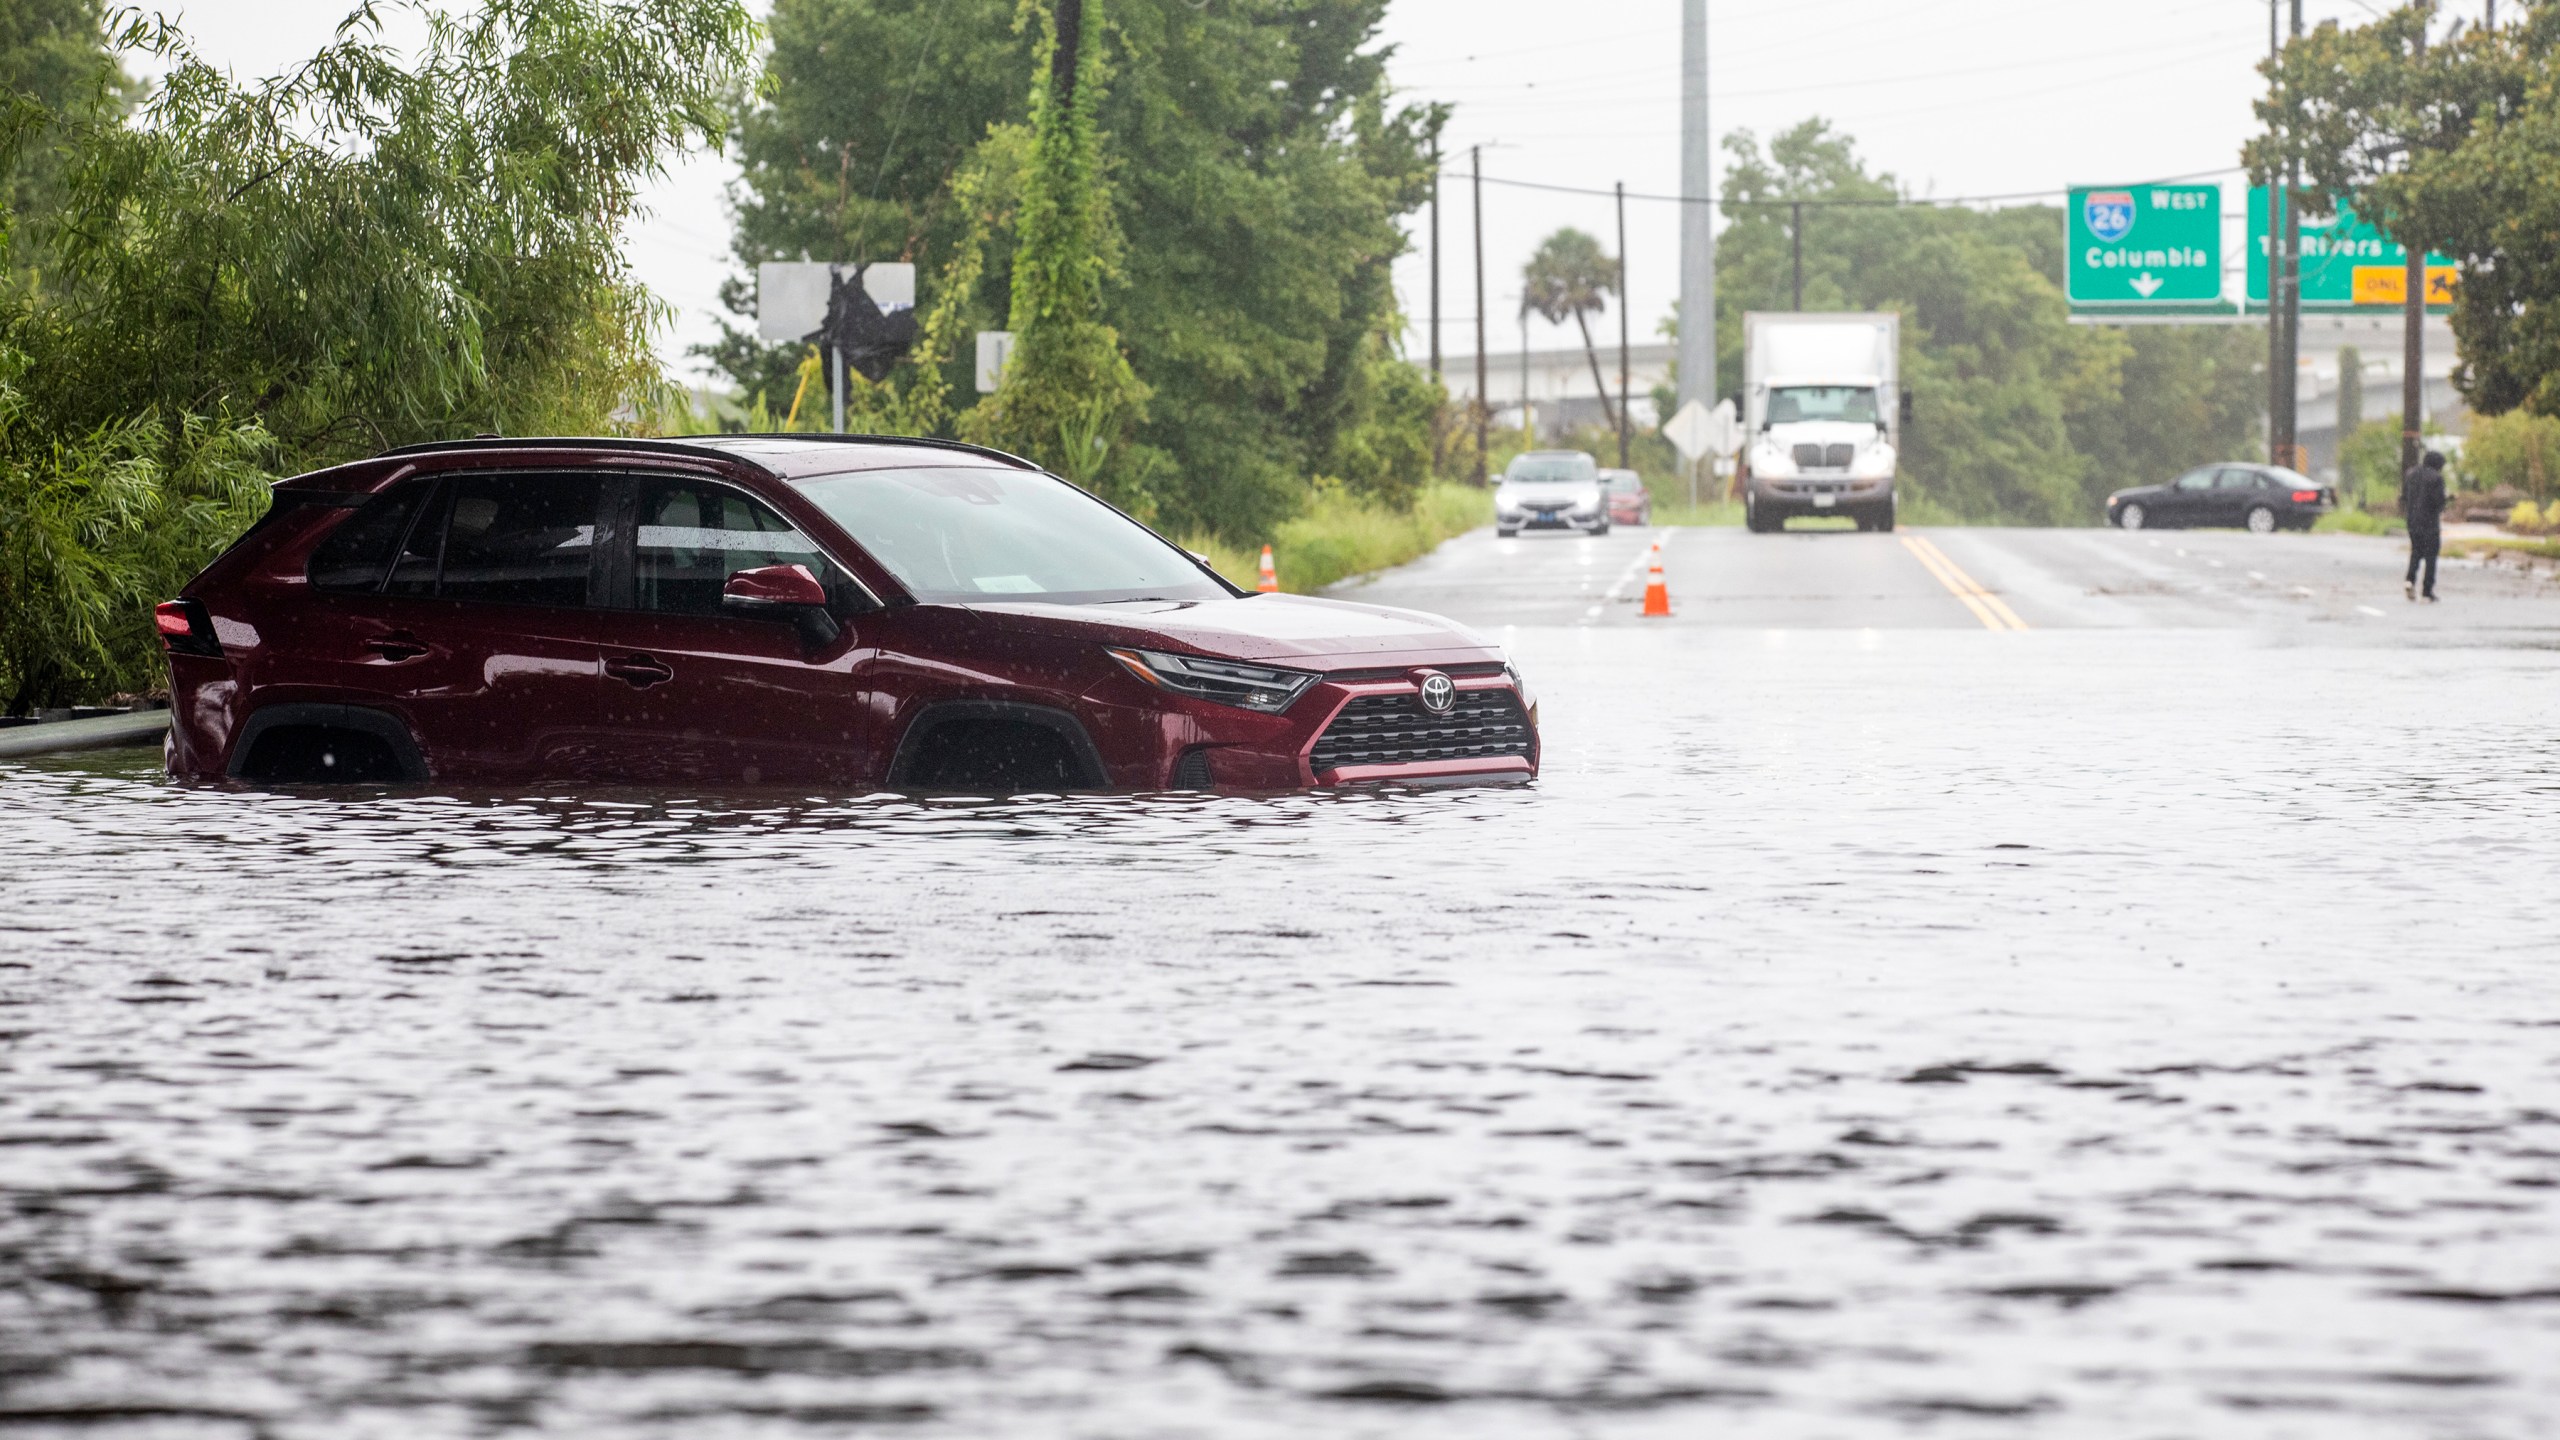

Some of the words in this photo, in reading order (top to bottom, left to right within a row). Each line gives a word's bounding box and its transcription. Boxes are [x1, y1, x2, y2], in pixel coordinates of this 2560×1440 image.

[2093, 205, 2127, 230] 26
[2299, 235, 2383, 257] Rivers
[2085, 246, 2207, 269] Columbia
[2365, 278, 2401, 291] ONL
